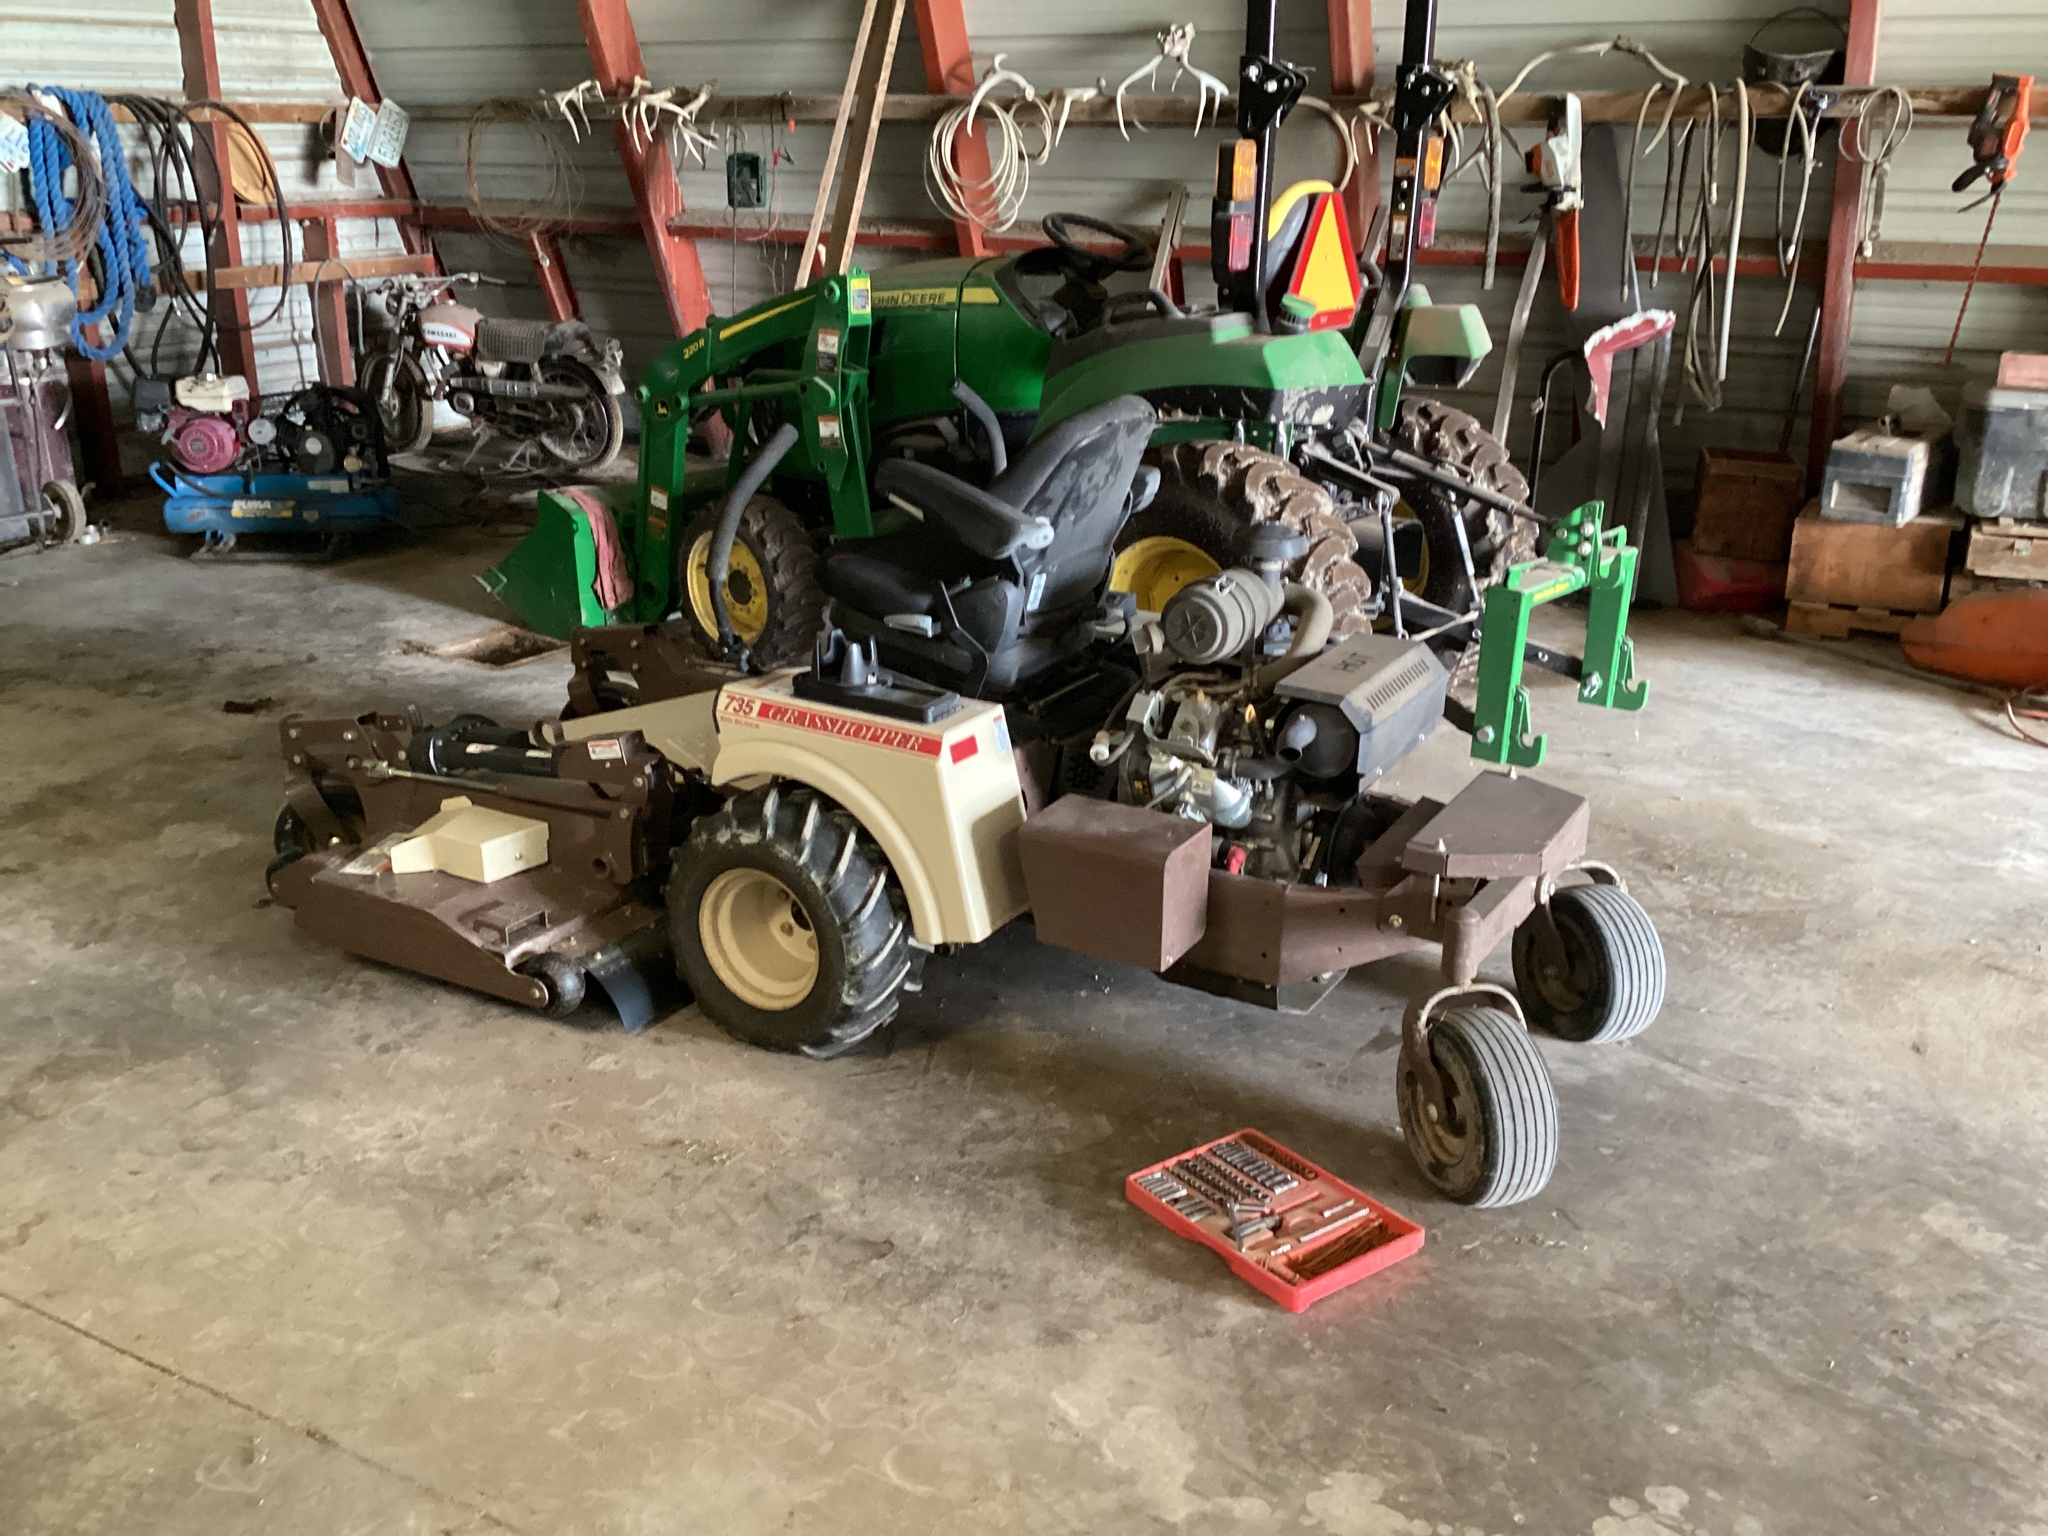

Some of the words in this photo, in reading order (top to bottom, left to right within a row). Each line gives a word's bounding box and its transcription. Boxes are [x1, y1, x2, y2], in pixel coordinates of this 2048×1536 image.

[872, 294, 900, 306] OHN
[902, 292, 946, 305] DEERE
[723, 694, 756, 716] 735
[767, 704, 924, 752] GRASSHOPPER
